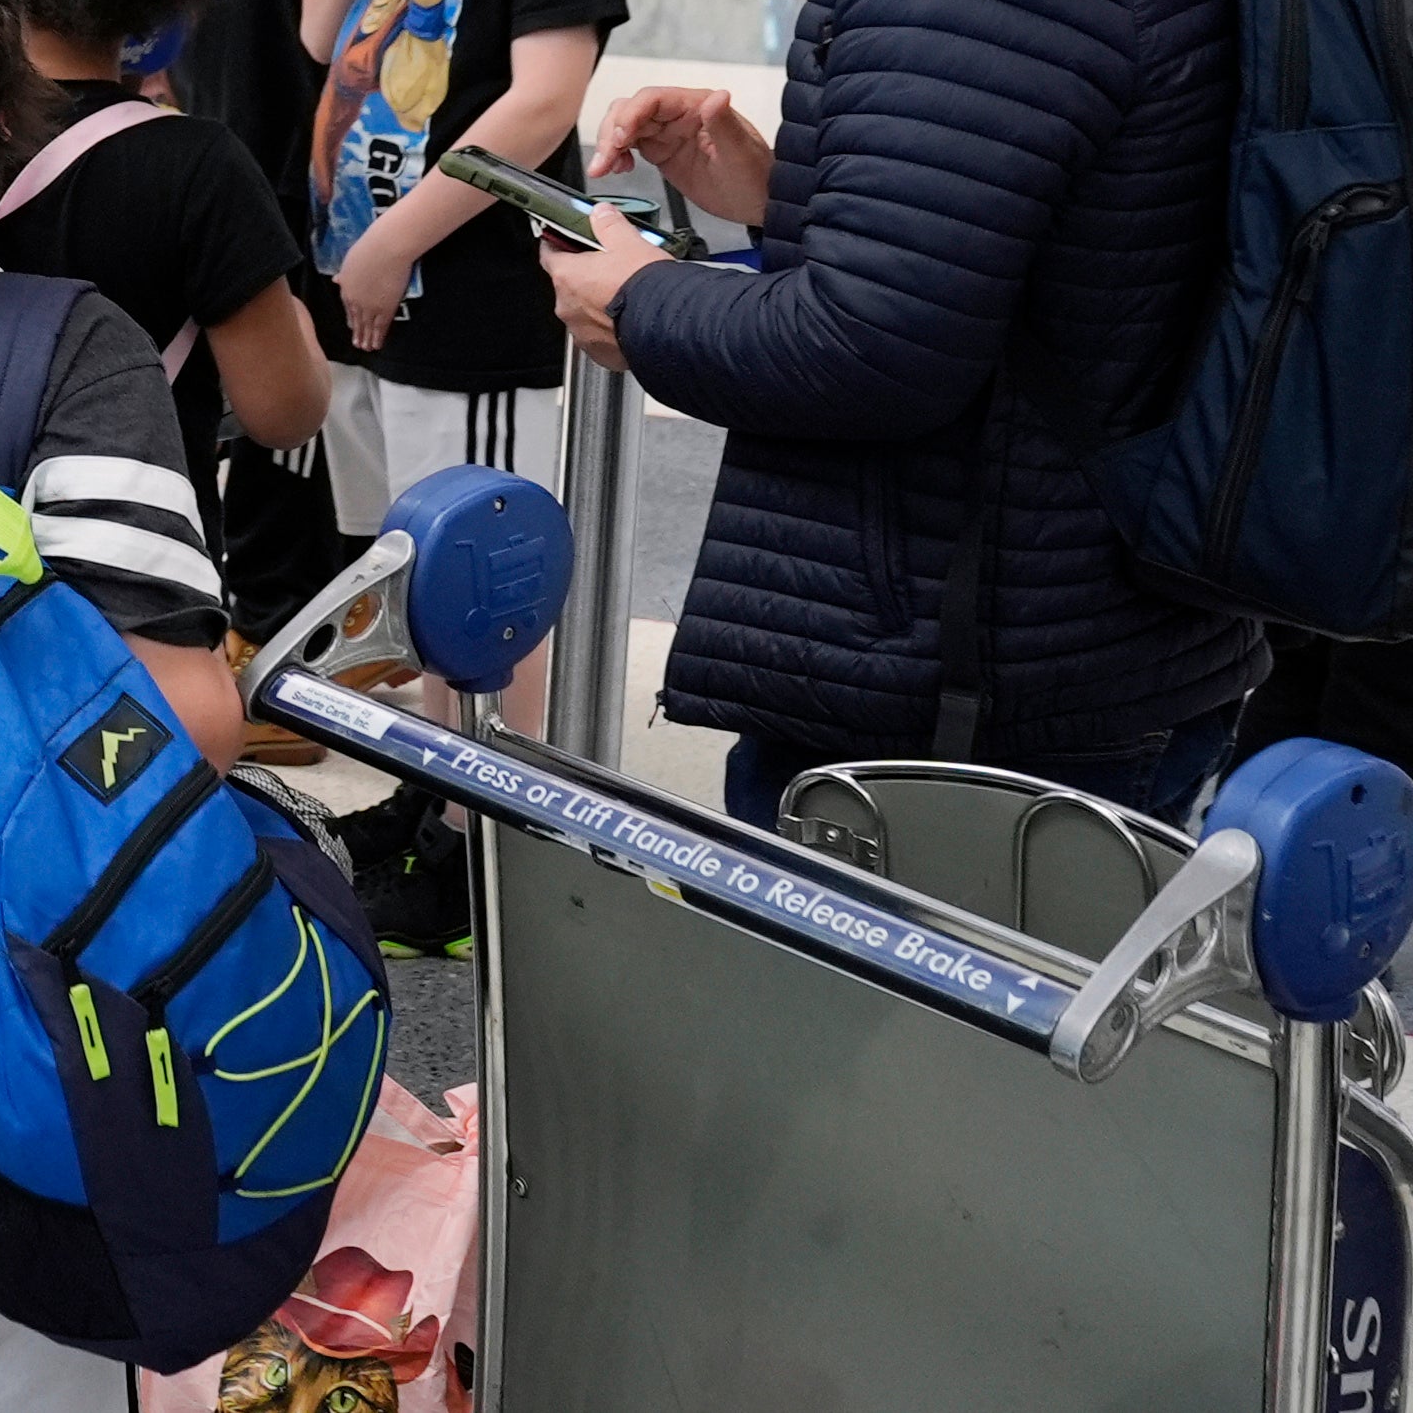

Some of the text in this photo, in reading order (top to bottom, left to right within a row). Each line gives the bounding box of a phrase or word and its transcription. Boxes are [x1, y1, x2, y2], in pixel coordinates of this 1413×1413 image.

[292, 691, 325, 711] Smarte
[325, 705, 351, 724] Carte,
[354, 717, 371, 731] Inc.
[450, 747, 993, 992] Press or Lift Handle to Release Brake
